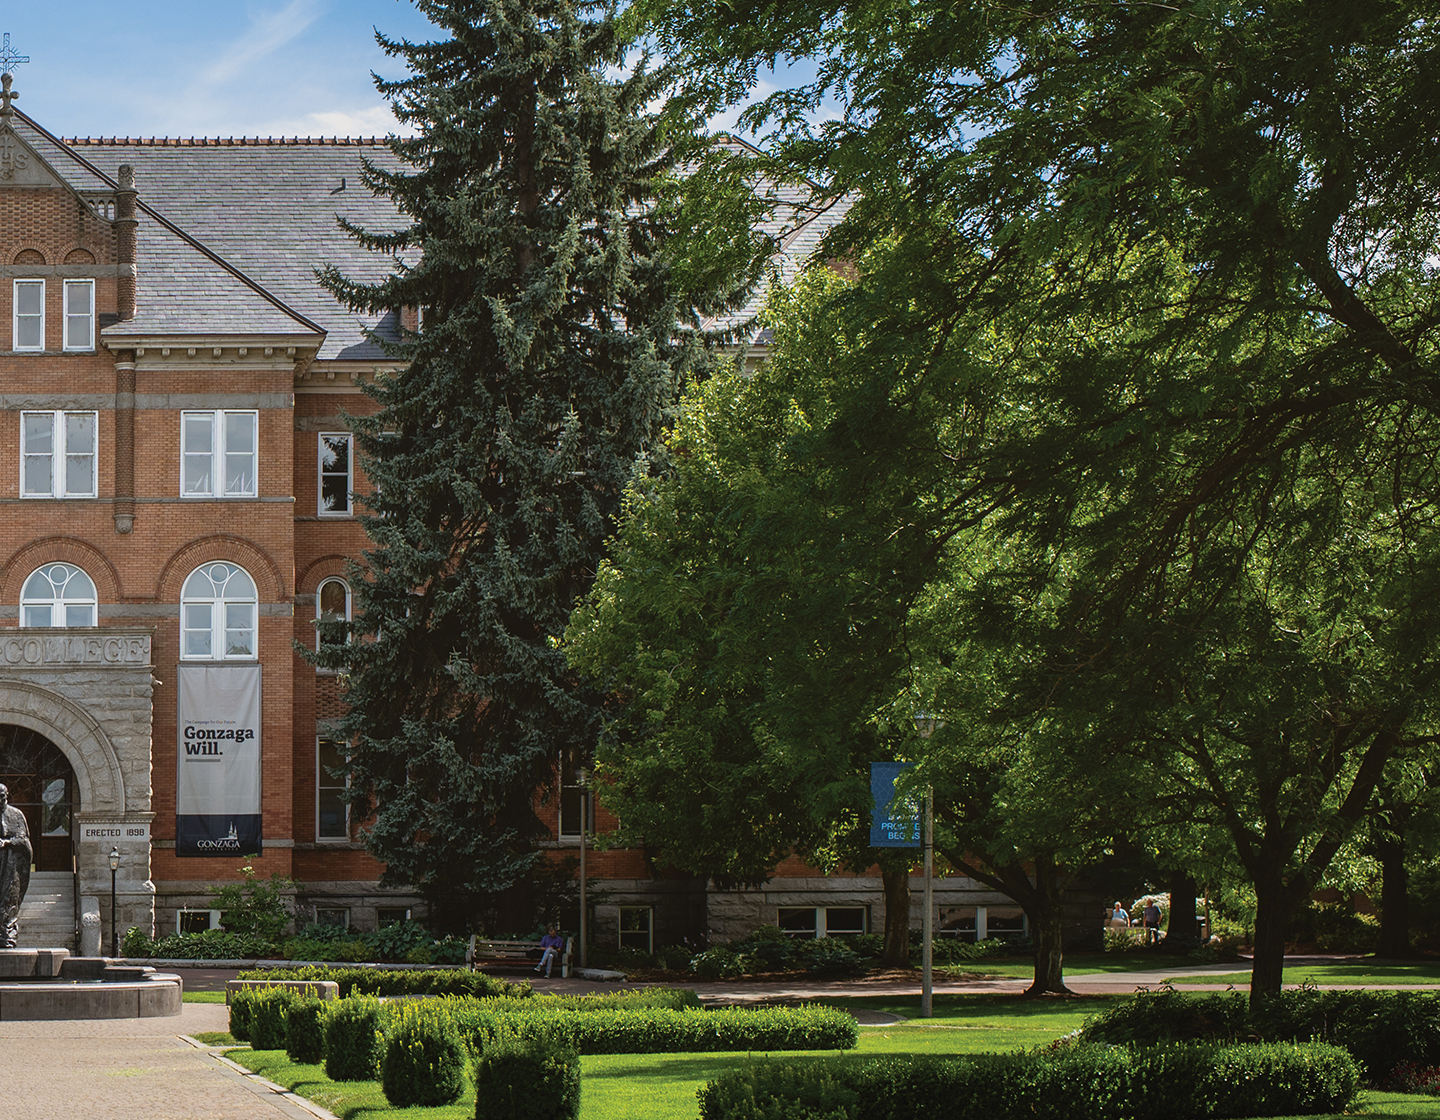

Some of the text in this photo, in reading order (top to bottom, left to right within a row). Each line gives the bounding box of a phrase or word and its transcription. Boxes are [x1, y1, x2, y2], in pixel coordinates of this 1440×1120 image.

[4, 638, 144, 664] COLLEGE
[184, 725, 255, 743] Gonzaga
[184, 741, 224, 755] Will.
[85, 828, 145, 837] ERECTED 1898
[196, 839, 241, 848] GONZAGA
